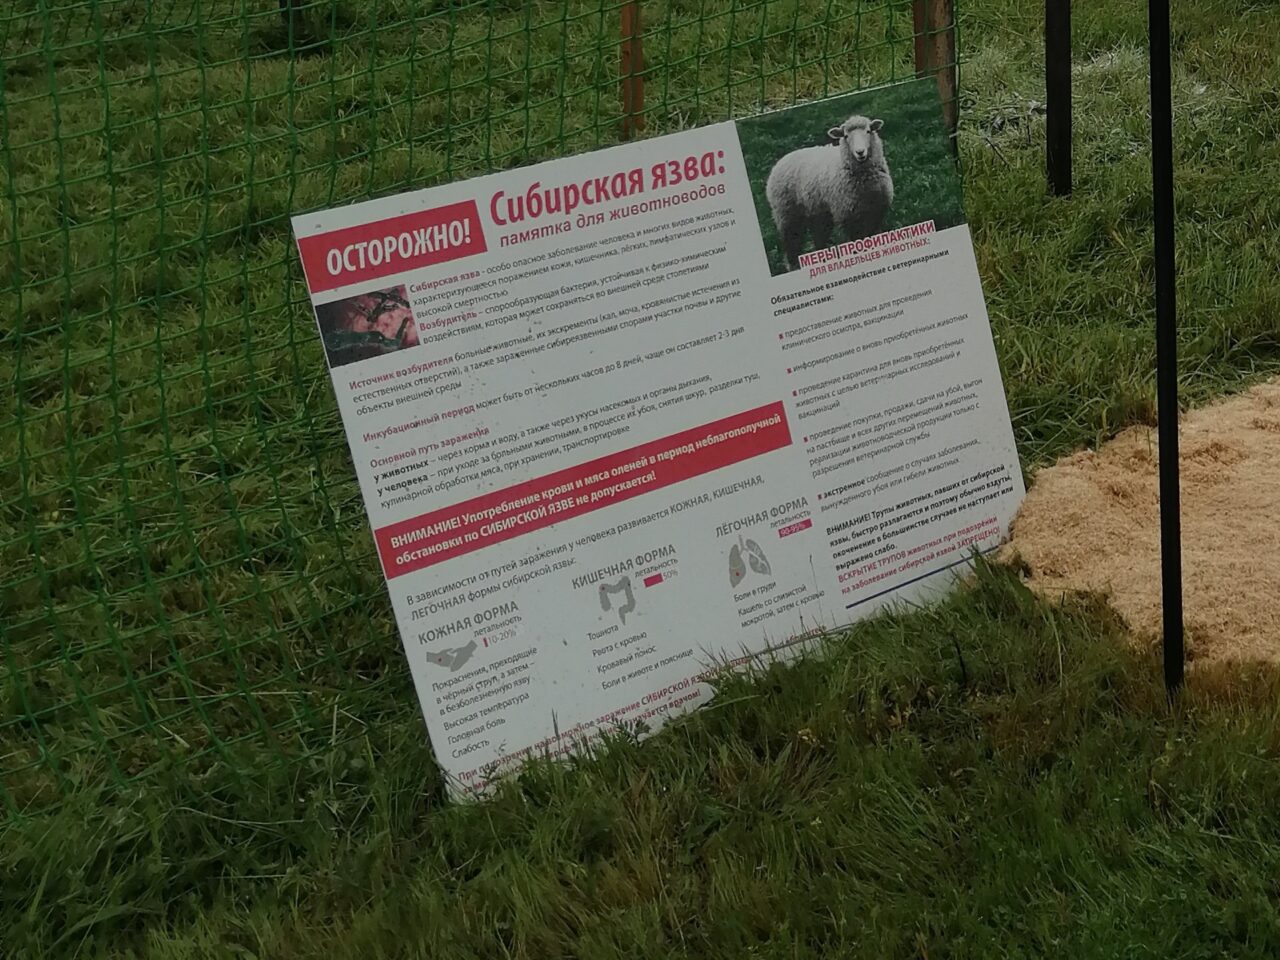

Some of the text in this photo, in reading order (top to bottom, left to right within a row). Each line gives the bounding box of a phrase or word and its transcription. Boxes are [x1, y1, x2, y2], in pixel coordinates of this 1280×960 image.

[488, 149, 726, 226] Сибирская язва:
[498, 182, 726, 248] памятка для животноводов
[325, 216, 471, 276] ОСТОРОЖНО!
[799, 221, 935, 267] МЕРЫ ПРОФИЛАКТИКИ
[808, 236, 931, 279] ДЛЯ ВЛАДЕЛЬЦЕВ ЖИВОТНЫХ:
[769, 248, 950, 305] Обязательное взаимодействие ветеринарными
[772, 293, 835, 317] специалистами:
[355, 379, 462, 416] объекты внешней среды
[368, 426, 490, 469] Основной путь заражения
[389, 412, 782, 549] ВНИМАНИЕ! Употребление крови мяса оленей период неблагополучной
[394, 468, 657, 565] обстановки СИБИРСКОЙ ЯЗВЕ допускается!
[714, 495, 809, 538] ЛЁГОЧНАЯ ФОРМА
[414, 473, 765, 604] зависимости путей заражения человека развивается КОЖНАЯ, КИШЕЧНАЯ,
[570, 542, 677, 590] КИШЕЧНАЯ ФОРМА
[410, 556, 577, 622] ЛЕГОЧНАЯ формы сибирской язвы:
[732, 580, 777, 603] Боли груди
[416, 599, 519, 646] КОЖНАЯ ФОРМА
[585, 623, 619, 641] Тошнота
[590, 630, 648, 658] Рвота кровью
[487, 646, 538, 671] преходящие
[595, 644, 657, 674] Кровавый понос
[600, 676, 621, 691] Боли
[625, 663, 654, 680] животе
[658, 647, 694, 667] пояснице
[442, 691, 530, 732] Высокая температура
[444, 674, 531, 714] безболезненную язву
[446, 717, 506, 746] Головная боль
[450, 738, 490, 759] Слабость
